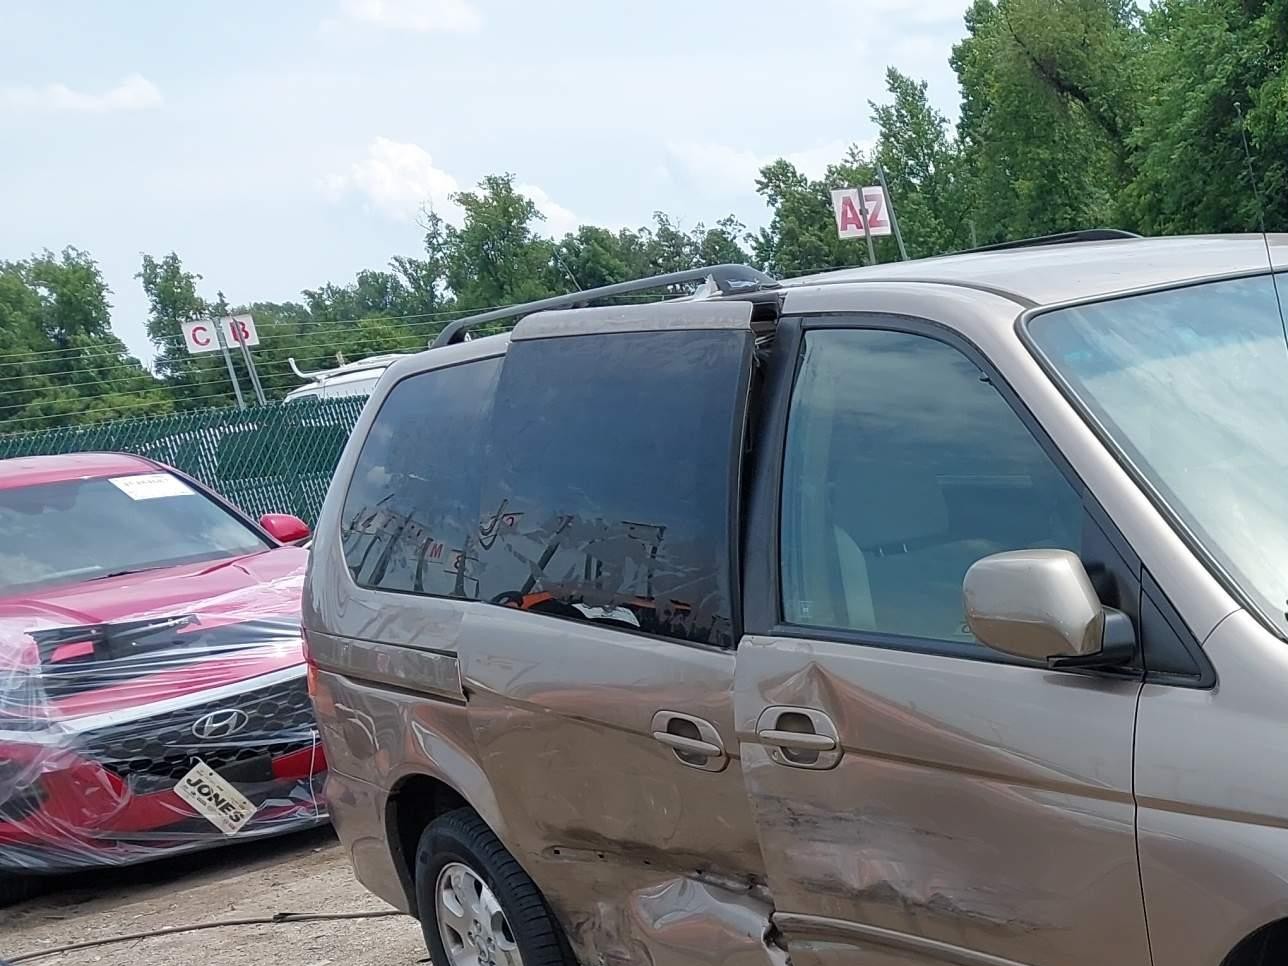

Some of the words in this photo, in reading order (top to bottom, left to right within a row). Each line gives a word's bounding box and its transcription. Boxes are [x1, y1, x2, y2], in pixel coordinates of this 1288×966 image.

[840, 193, 888, 231] AZ
[192, 326, 210, 346] C
[230, 321, 250, 343] B
[186, 778, 245, 823] JONES
